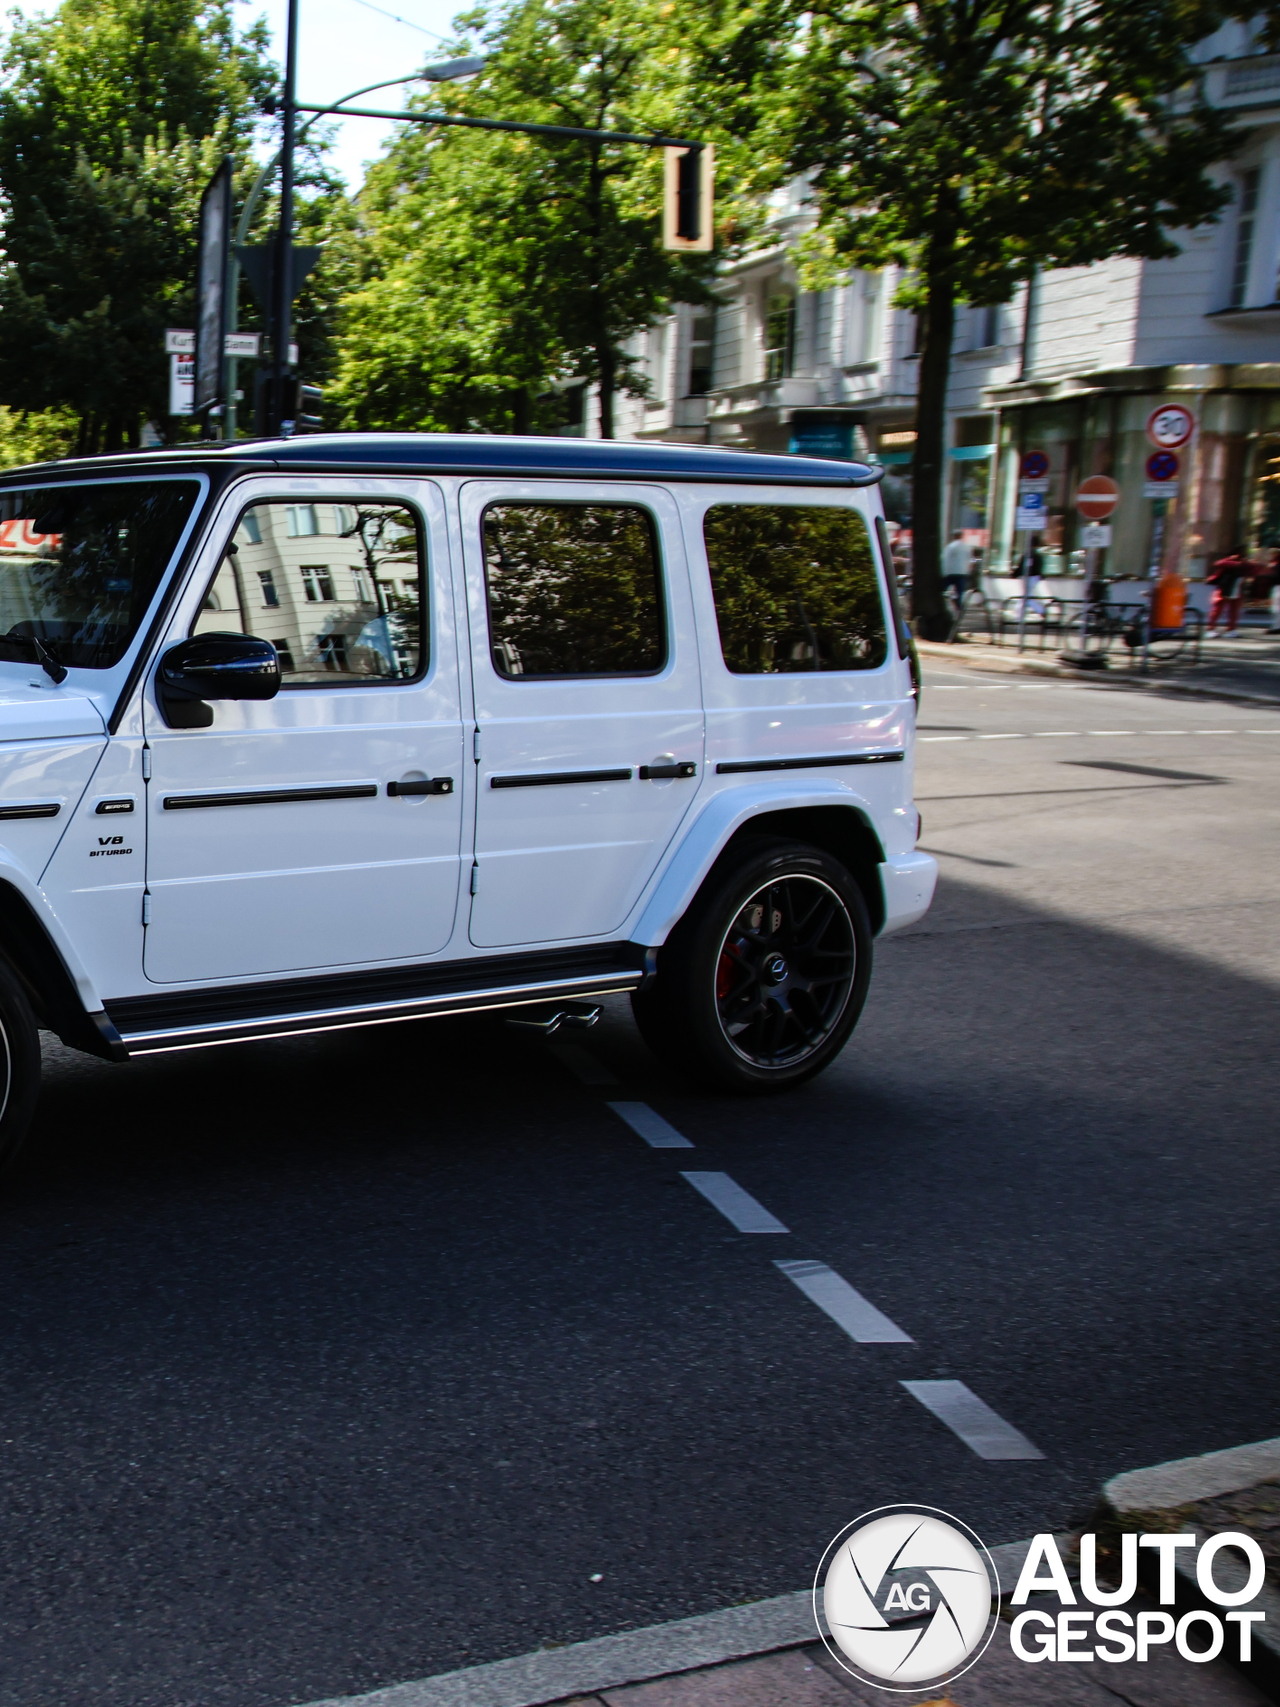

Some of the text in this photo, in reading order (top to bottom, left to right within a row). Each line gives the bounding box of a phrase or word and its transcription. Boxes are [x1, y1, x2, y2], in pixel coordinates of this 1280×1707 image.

[1158, 415, 1186, 437] 30
[98, 835, 124, 846] V8
[89, 848, 133, 857] BITURBO
